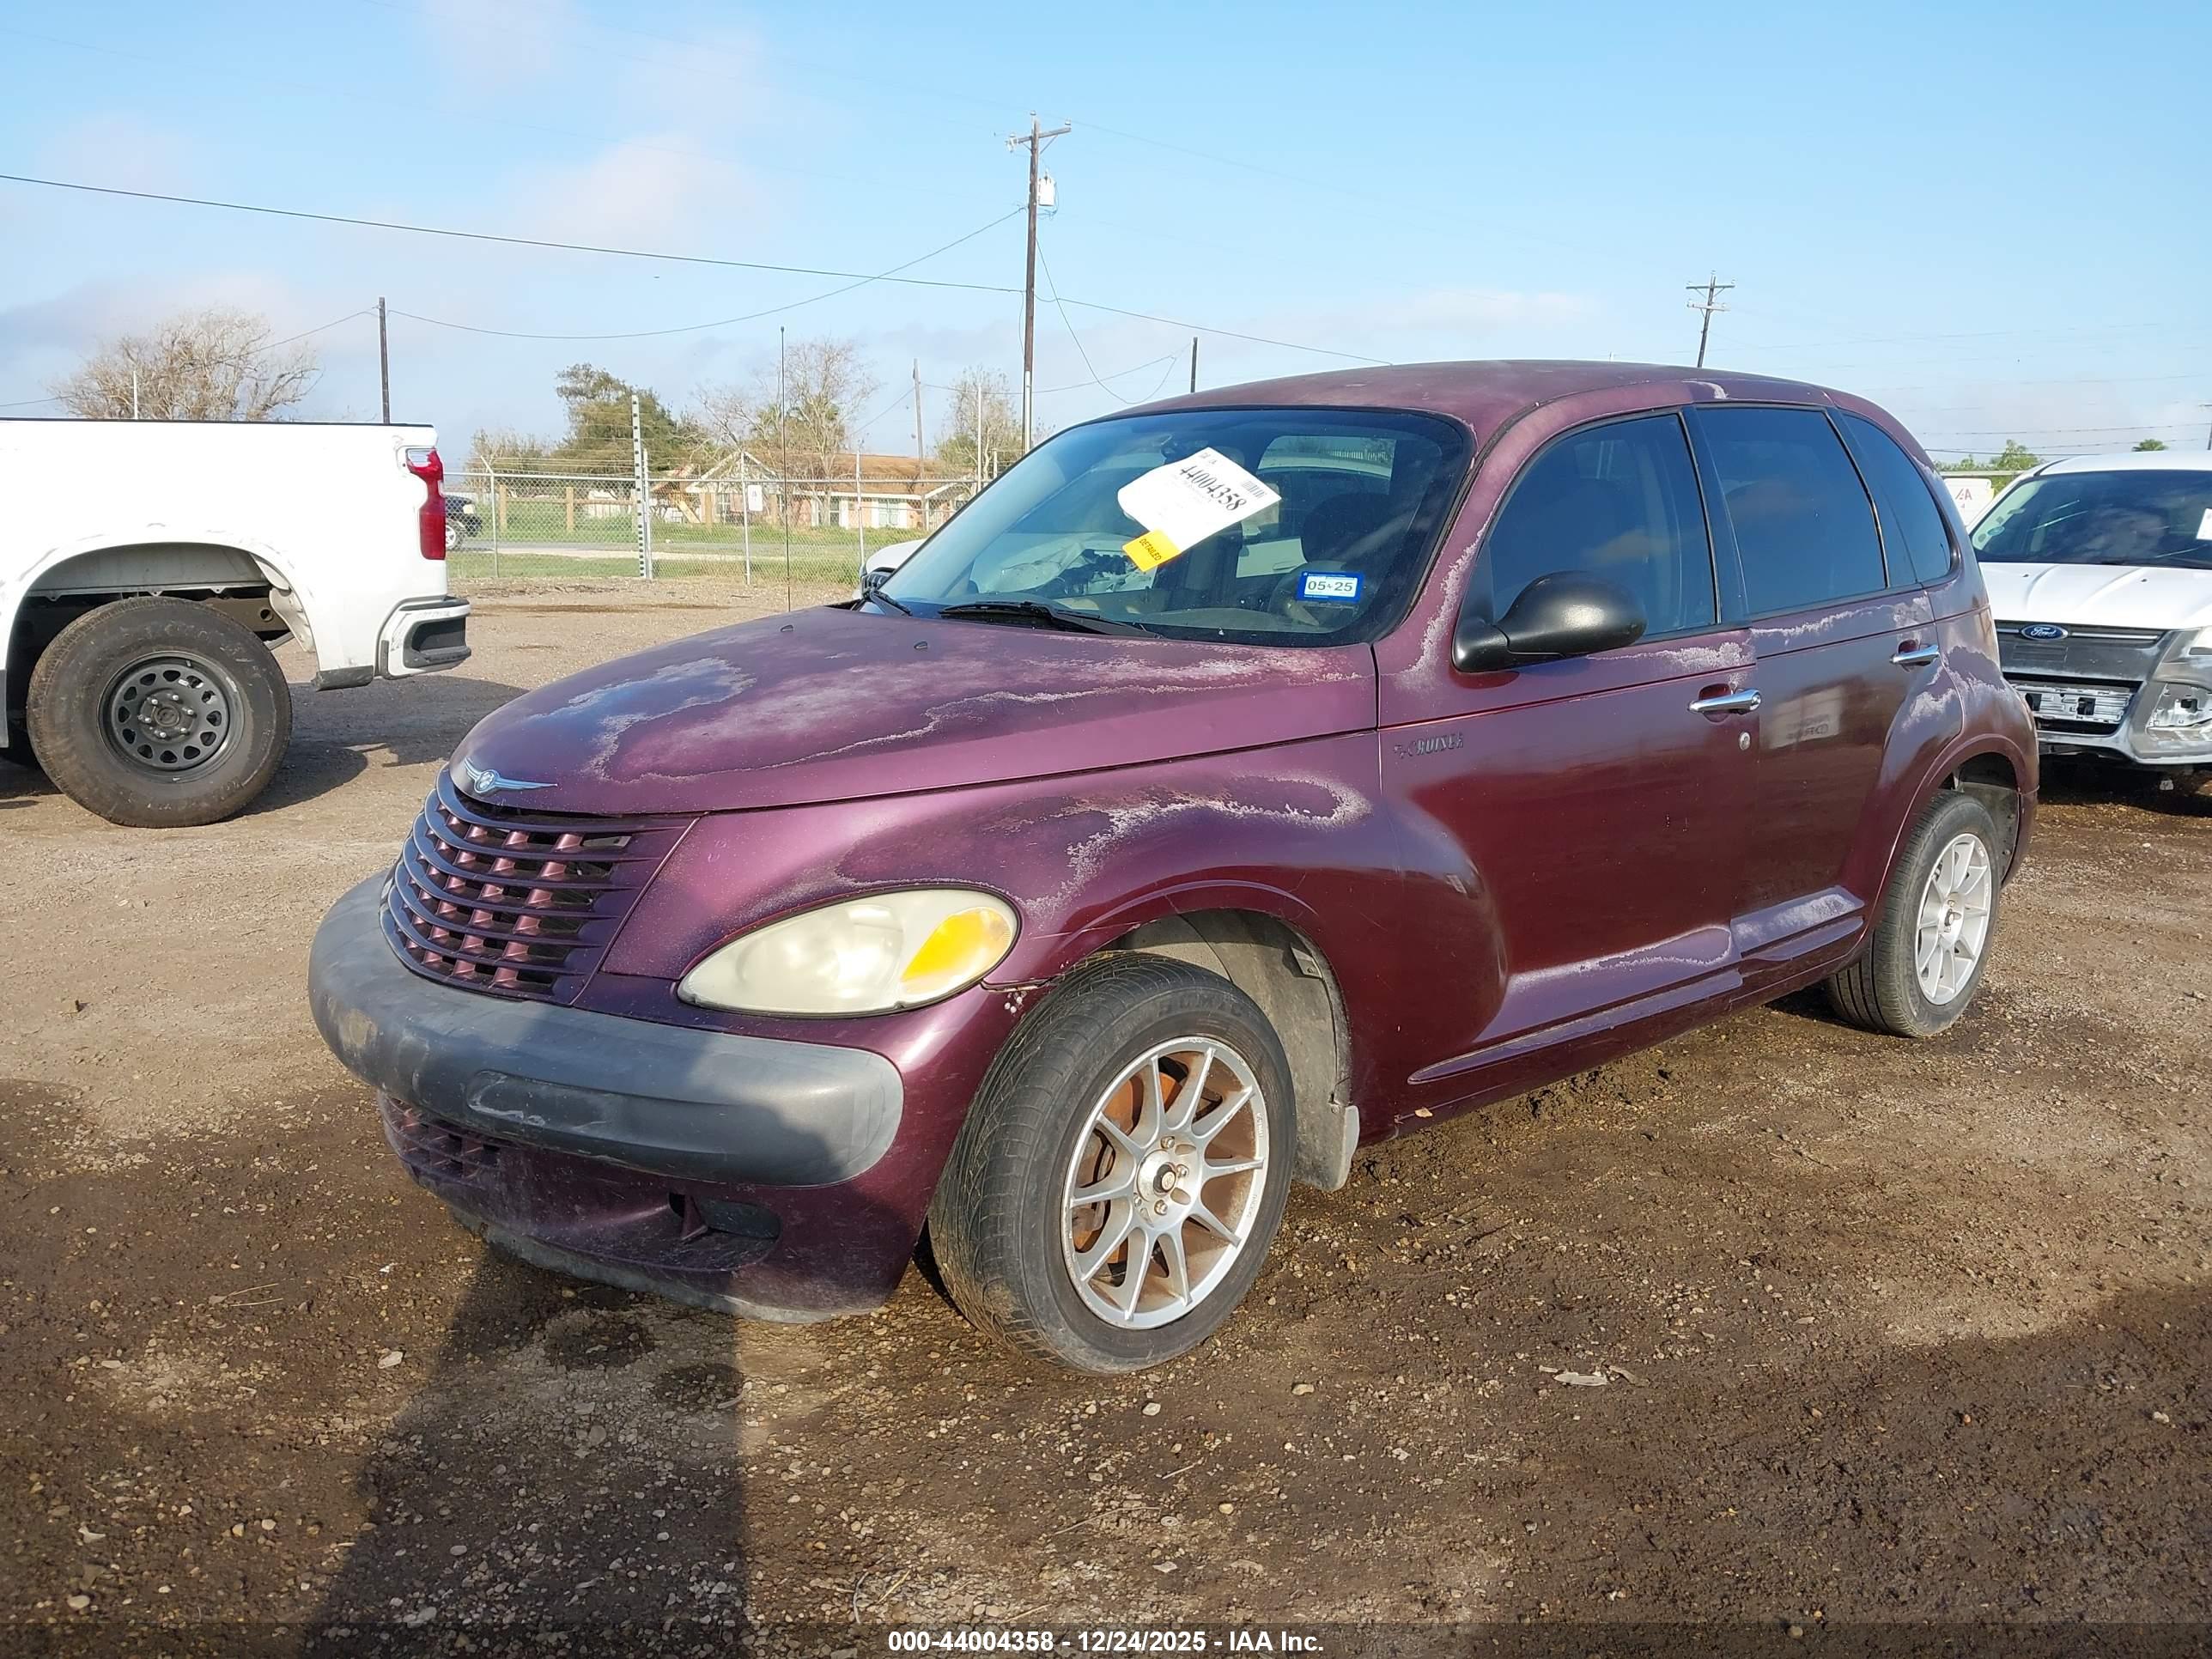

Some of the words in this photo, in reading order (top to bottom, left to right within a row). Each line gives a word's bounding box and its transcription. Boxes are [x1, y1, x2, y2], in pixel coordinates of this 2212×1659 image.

[1179, 465, 1248, 511] 44004358
[1139, 538, 1162, 561] DETAILED
[2030, 626, 2057, 637] Ford
